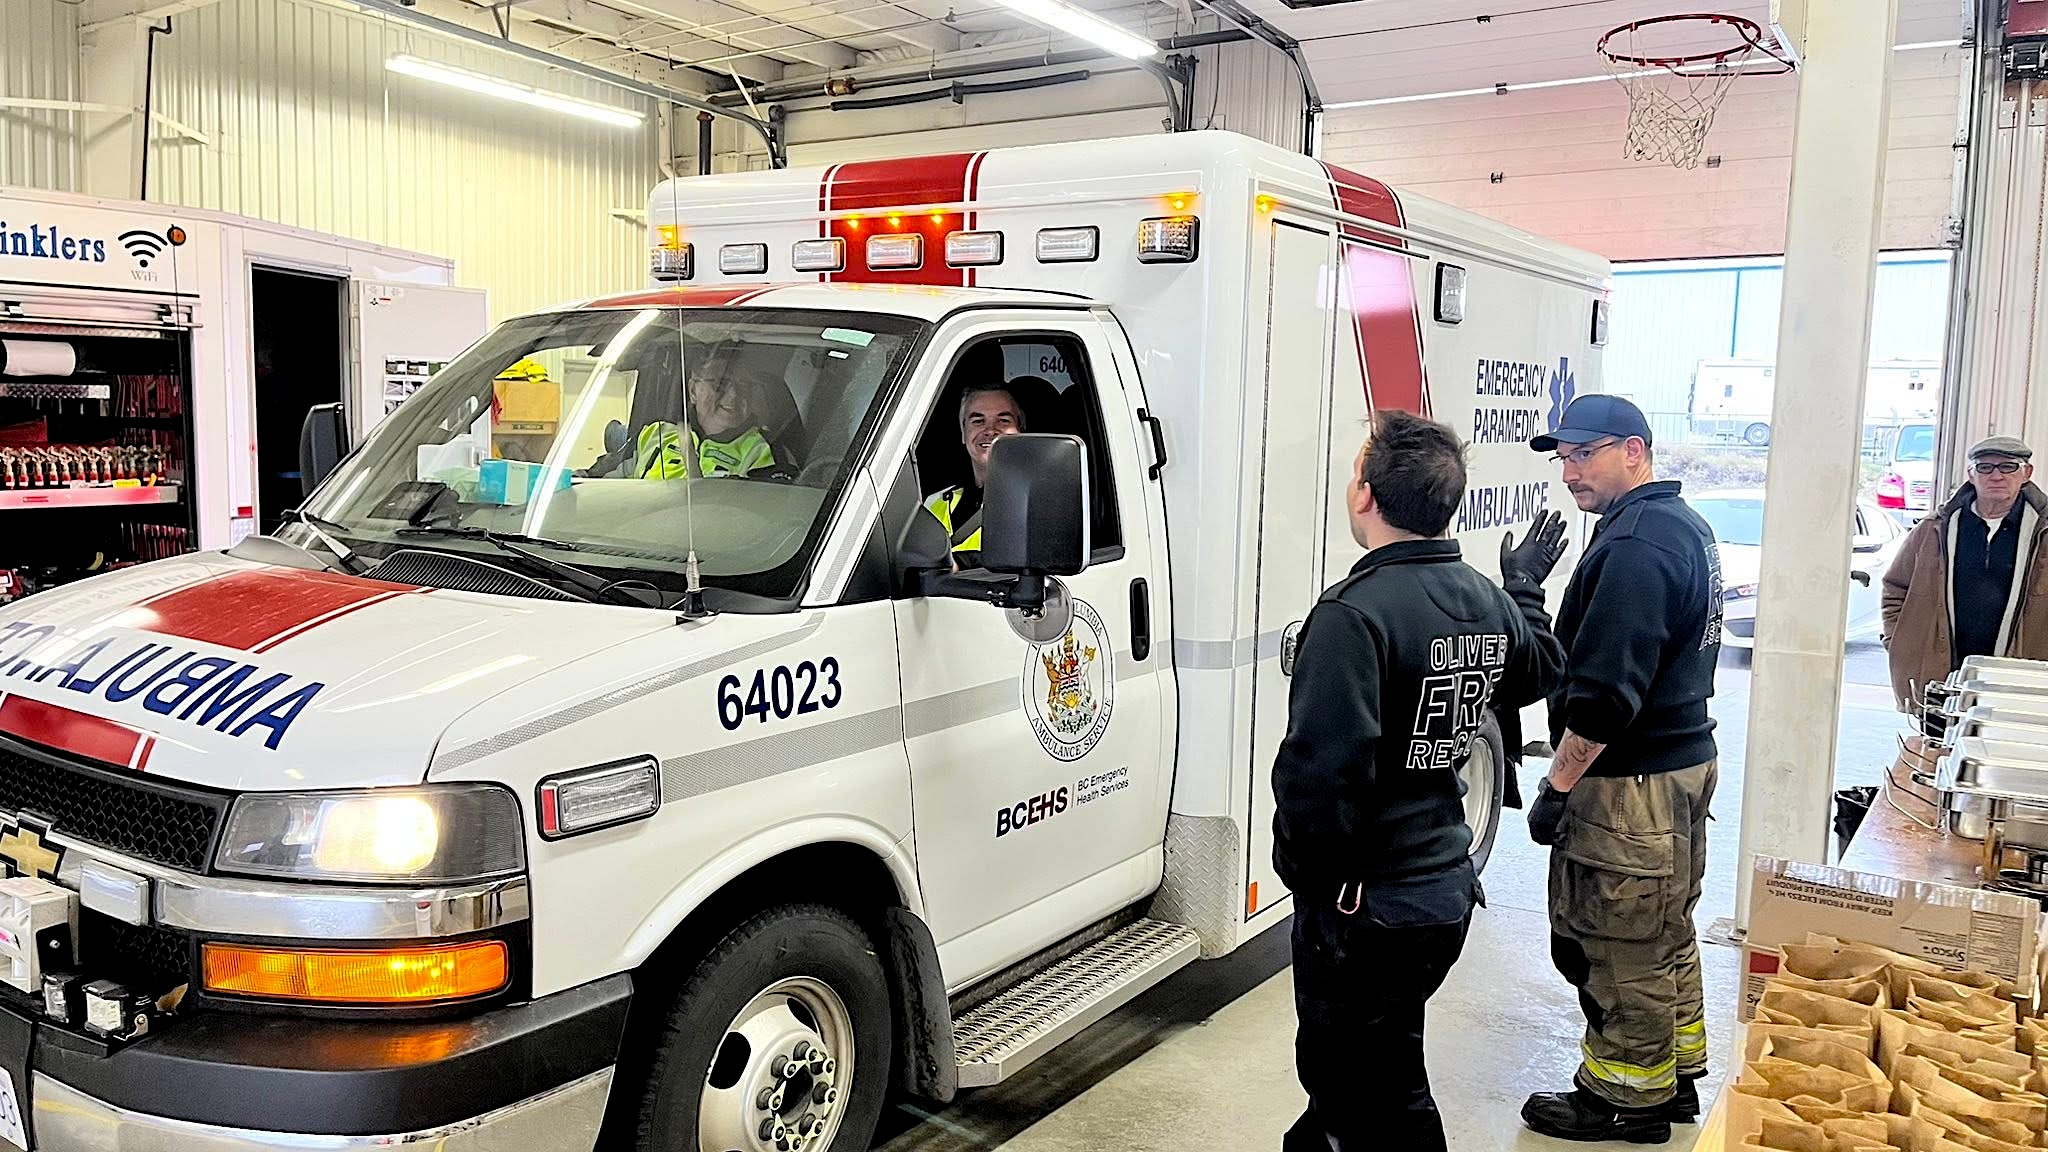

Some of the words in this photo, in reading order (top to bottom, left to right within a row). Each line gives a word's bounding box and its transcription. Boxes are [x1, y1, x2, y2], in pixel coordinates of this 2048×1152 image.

[0, 221, 105, 262] inklers
[131, 270, 158, 282] WiFi
[1040, 355, 1069, 374] 640
[1476, 359, 1546, 398] EMERGENCY
[1473, 408, 1540, 444] PARAMEDIC
[1456, 481, 1549, 533] AMBULANCE
[1074, 601, 1103, 637] LUMBIA
[1431, 634, 1508, 671] OLIVER
[717, 656, 843, 731] 64023
[1032, 716, 1082, 758] AMBULANCE
[1083, 697, 1111, 750] SERVICE
[1077, 778, 1089, 792] BC
[1090, 766, 1129, 787] Emergency
[1077, 790, 1099, 806] Health
[1100, 779, 1129, 798] Services
[996, 786, 1069, 838] BCEHS
[1819, 898, 1845, 909] FROM
[1845, 904, 1870, 913] AWAY
[1871, 907, 1893, 917] KEEP
[1931, 946, 1966, 962] Sysco
